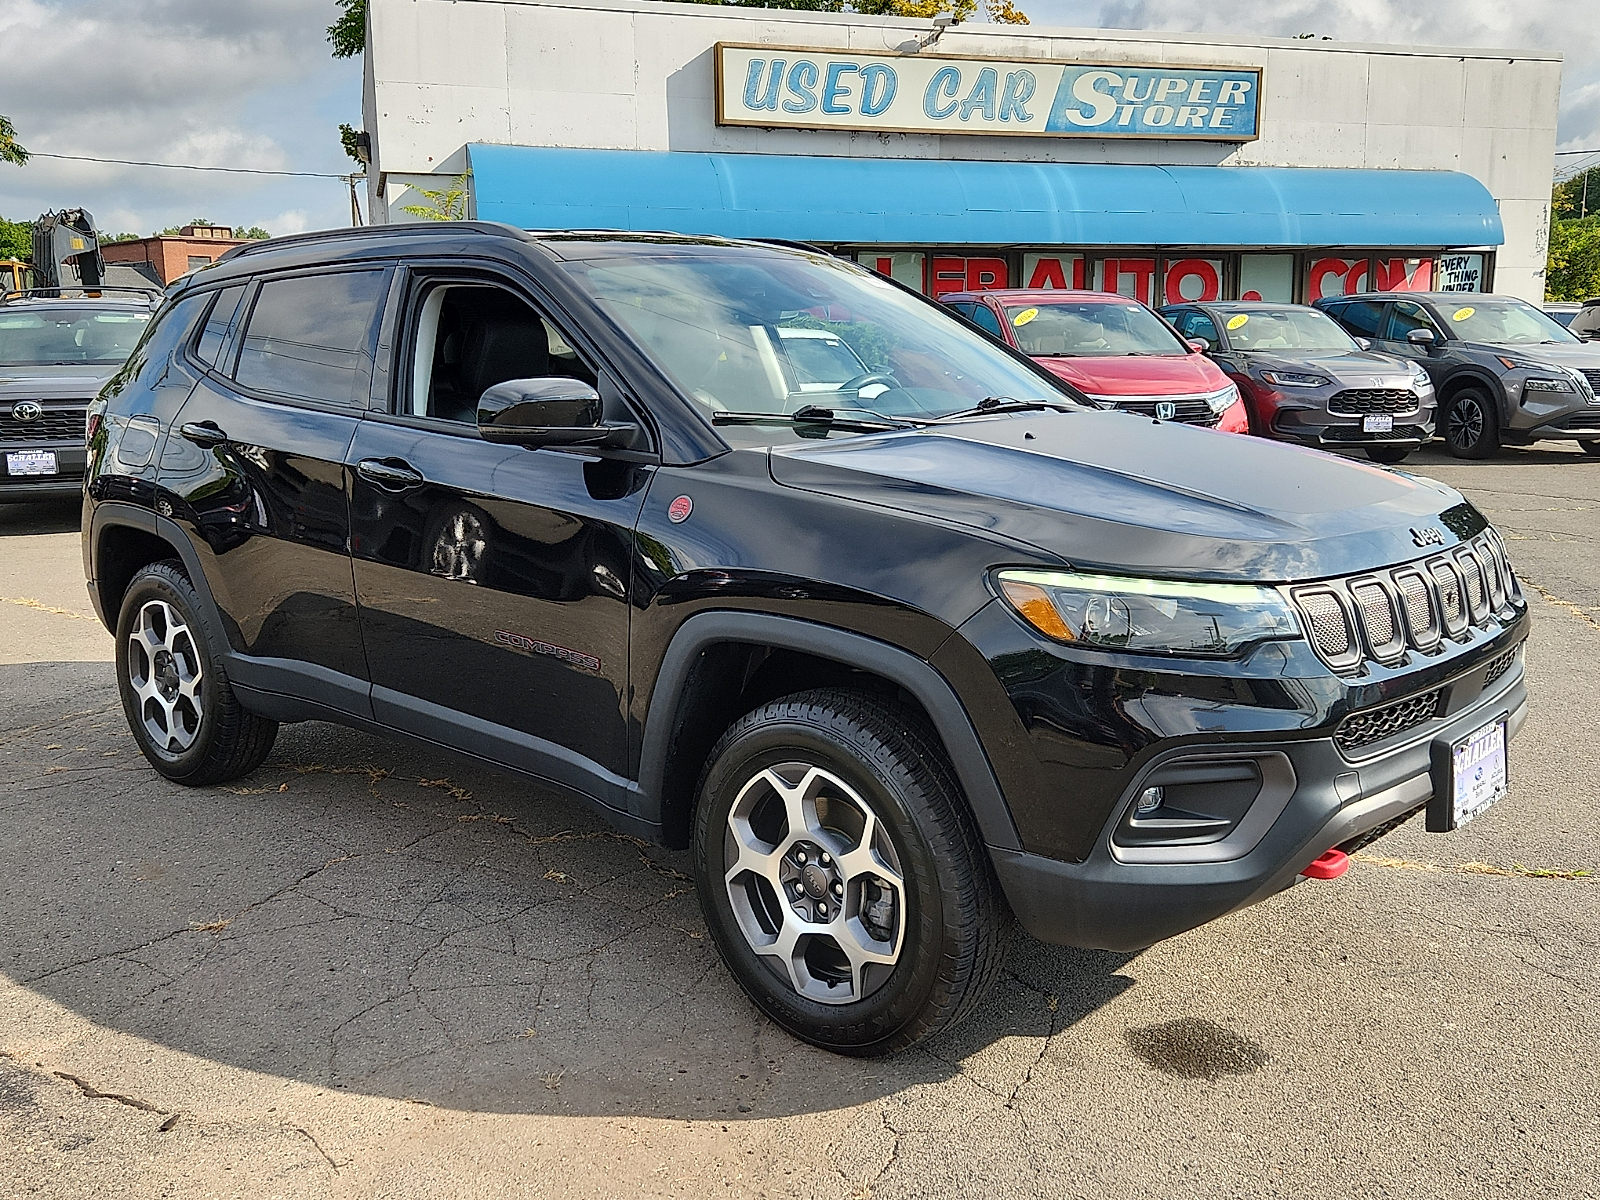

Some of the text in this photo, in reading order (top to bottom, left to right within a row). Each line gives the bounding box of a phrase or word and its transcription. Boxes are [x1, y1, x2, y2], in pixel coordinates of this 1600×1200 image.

[743, 59, 1036, 123] USED CAR
[1066, 71, 1252, 126] SUPER
[1440, 256, 1470, 274] EVERY
[1447, 269, 1479, 284] THING
[8, 453, 56, 462] SCHALLER
[1409, 527, 1446, 548] Jeep
[494, 629, 601, 670] COMPASS
